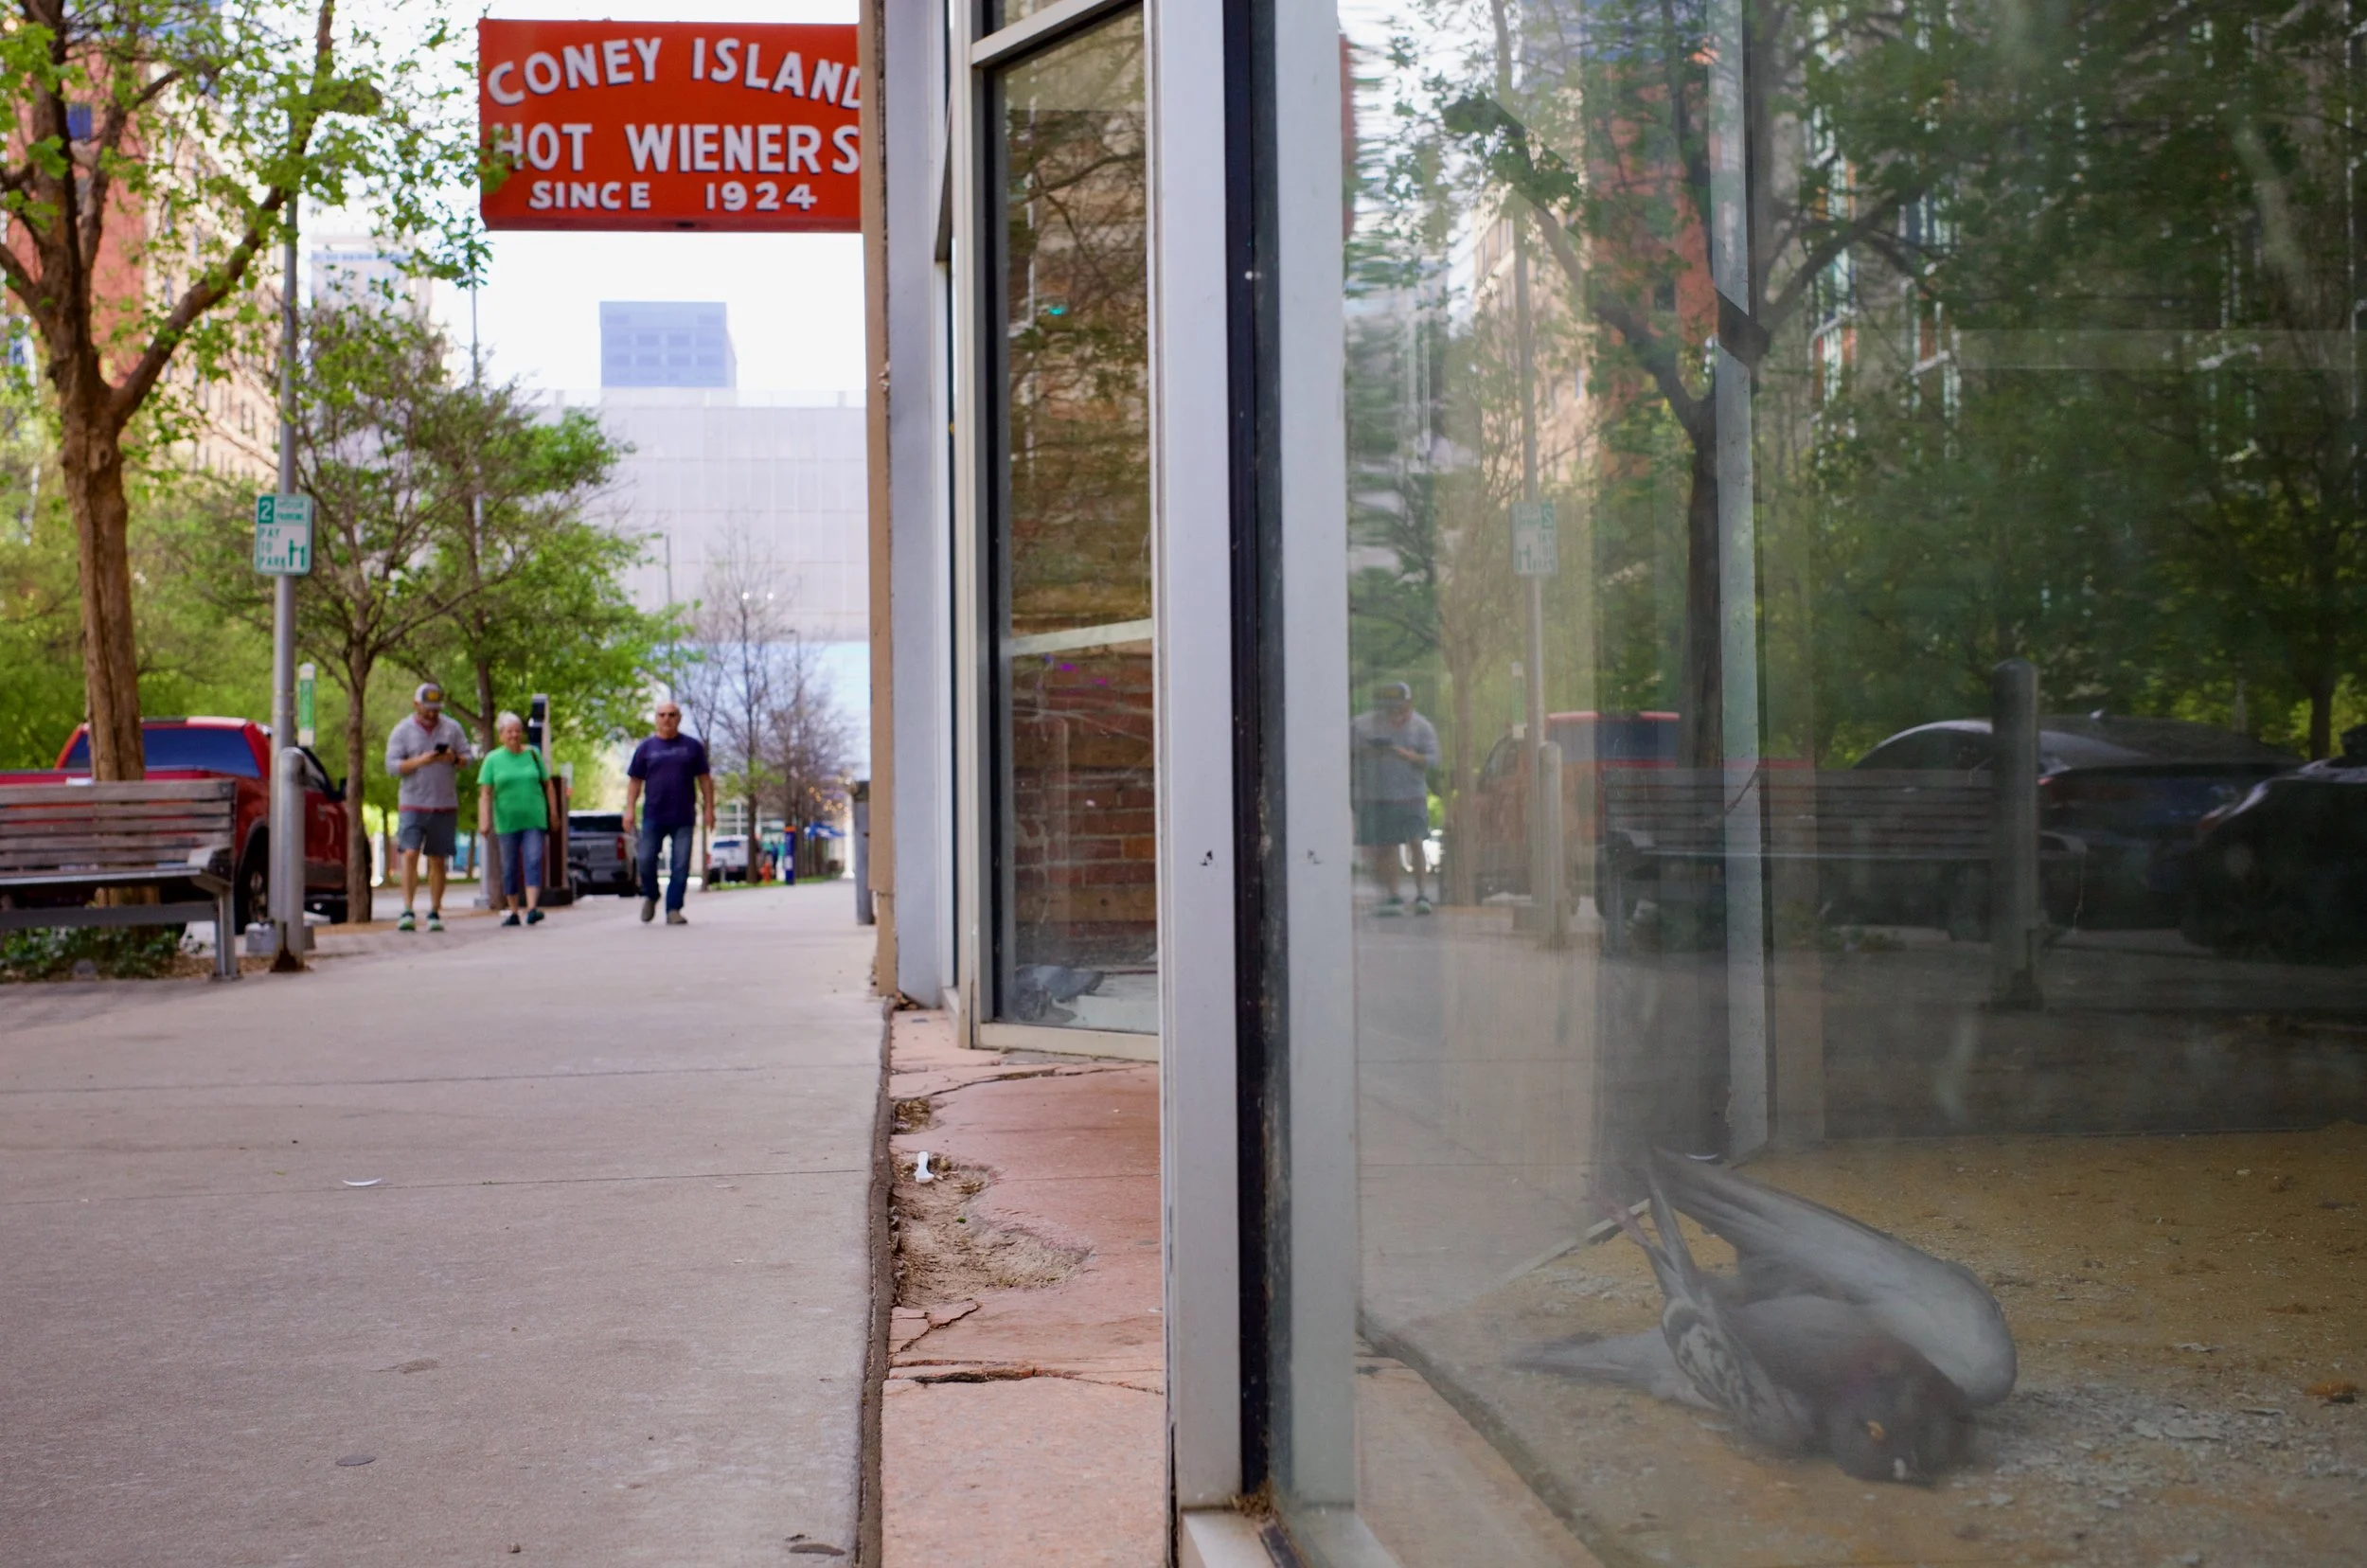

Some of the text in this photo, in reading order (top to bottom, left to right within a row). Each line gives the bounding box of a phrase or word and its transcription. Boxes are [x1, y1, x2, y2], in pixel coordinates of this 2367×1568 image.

[487, 37, 662, 106] CONEY
[492, 122, 861, 174] HOT WIENERS
[528, 181, 818, 211] SINCE 1924
[259, 500, 273, 522] 2
